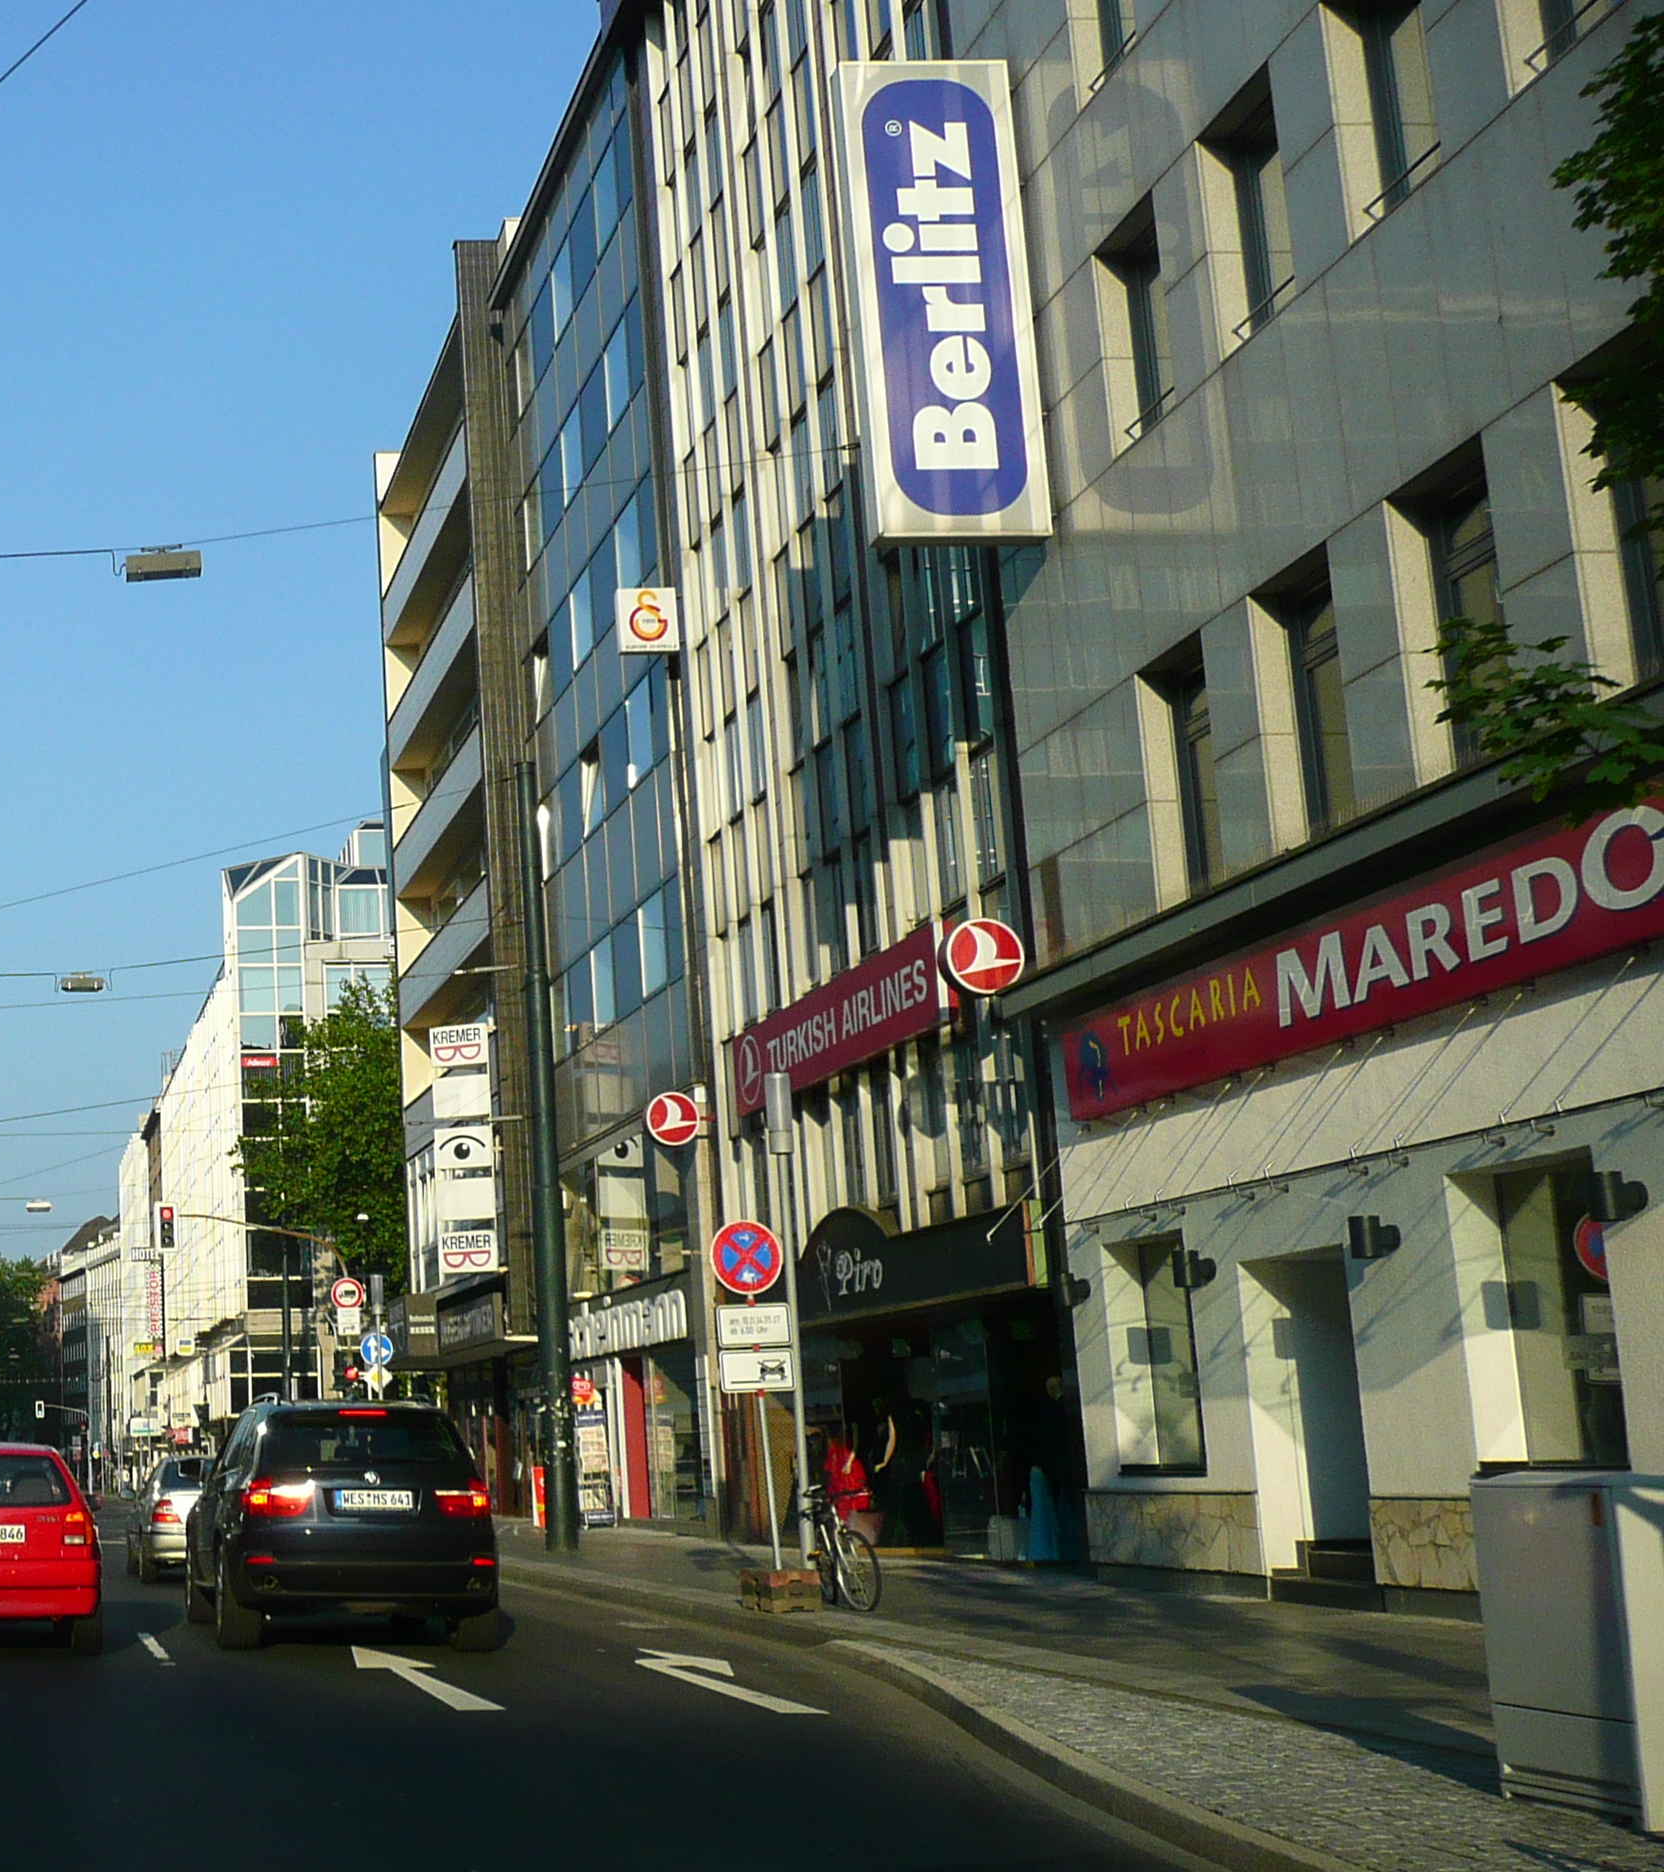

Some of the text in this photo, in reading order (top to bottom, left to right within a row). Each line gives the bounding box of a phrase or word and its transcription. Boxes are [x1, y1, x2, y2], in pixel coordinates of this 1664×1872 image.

[882, 120, 1000, 471] Berlitz
[1118, 804, 1664, 1056] TASCARIA MAREDO
[767, 959, 927, 1074] TURKISH AIRLINES
[432, 1027, 481, 1045] KREMER
[132, 1248, 160, 1261] HOTEL
[442, 1234, 491, 1250] KREMER
[835, 1247, 883, 1296] Piro
[343, 1493, 364, 1505] WES
[390, 1493, 411, 1506] 641
